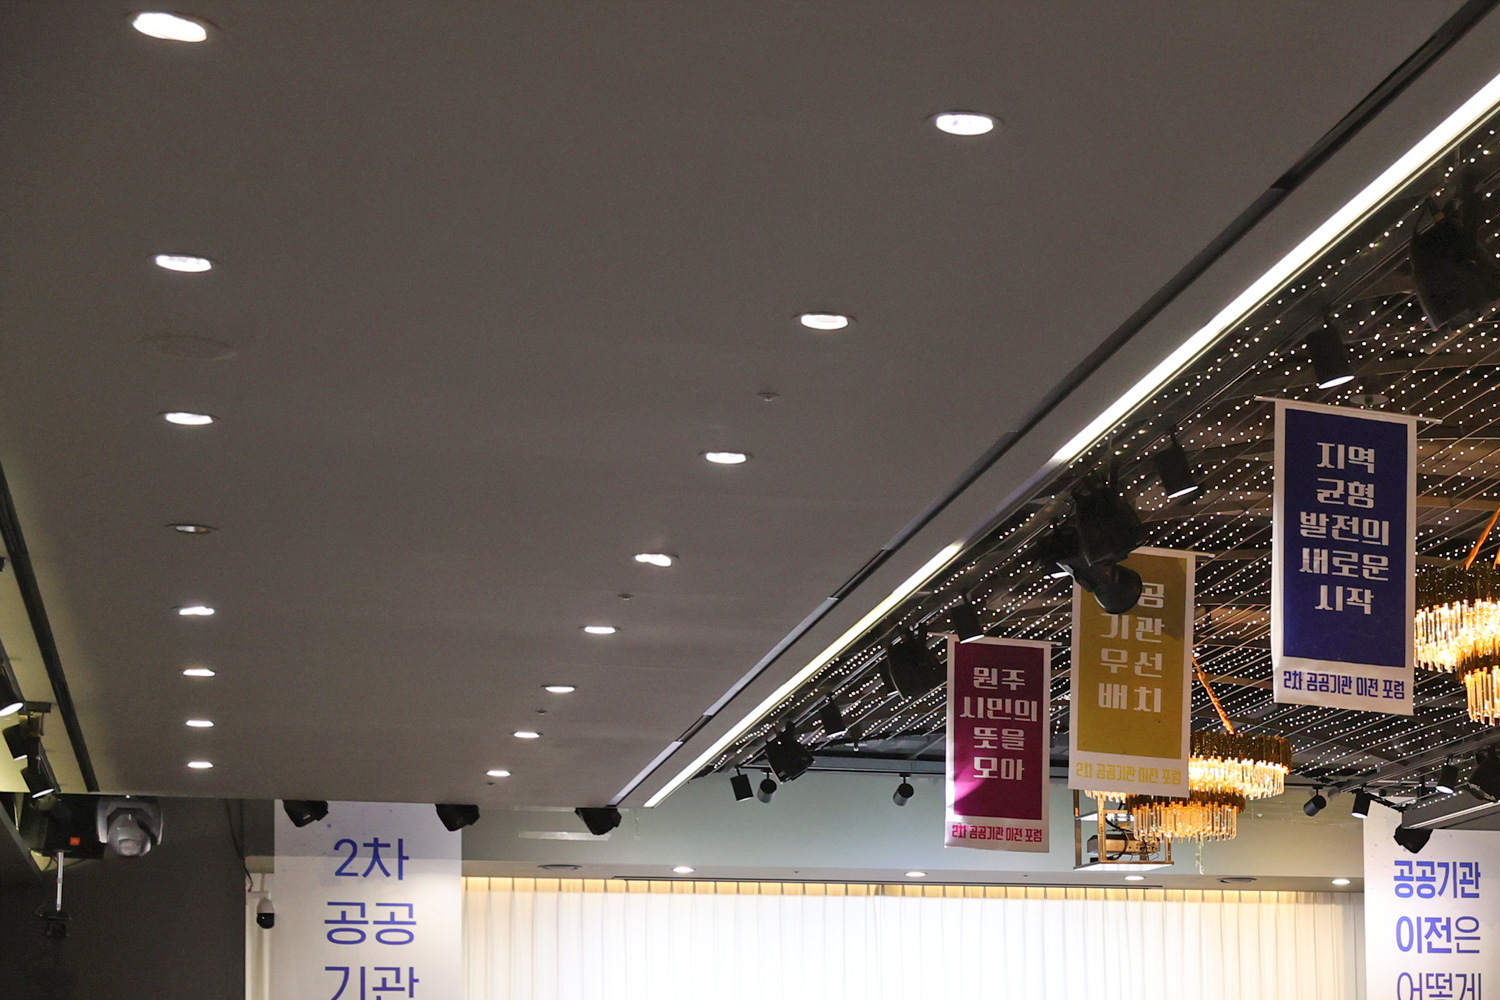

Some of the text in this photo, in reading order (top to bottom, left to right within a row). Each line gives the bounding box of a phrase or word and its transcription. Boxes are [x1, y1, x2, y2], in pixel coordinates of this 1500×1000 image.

[1317, 442, 1375, 474] 지역
[1317, 477, 1375, 509] 균형
[1300, 511, 1389, 546] 발전의
[1299, 547, 1389, 581] 새로운
[1315, 585, 1374, 615] 시작
[1100, 613, 1165, 643] 기관
[1100, 648, 1163, 678] 우선
[973, 667, 1025, 691] 원주
[1283, 671, 1404, 699] 2차 공공기관 이전 포럼
[960, 696, 1038, 722] 시민의
[1098, 683, 1162, 713] 배치
[973, 727, 1025, 751] 뜻을
[973, 756, 1025, 781] 모아
[1076, 762, 1182, 786] 2차 공공기관 이전 포럼
[952, 824, 1042, 843] 2차 공공기관 이전 포럼
[333, 837, 409, 881] 2차
[1393, 860, 1481, 899] 공공기관
[324, 901, 417, 945] 공공
[1395, 916, 1481, 954] 이전은
